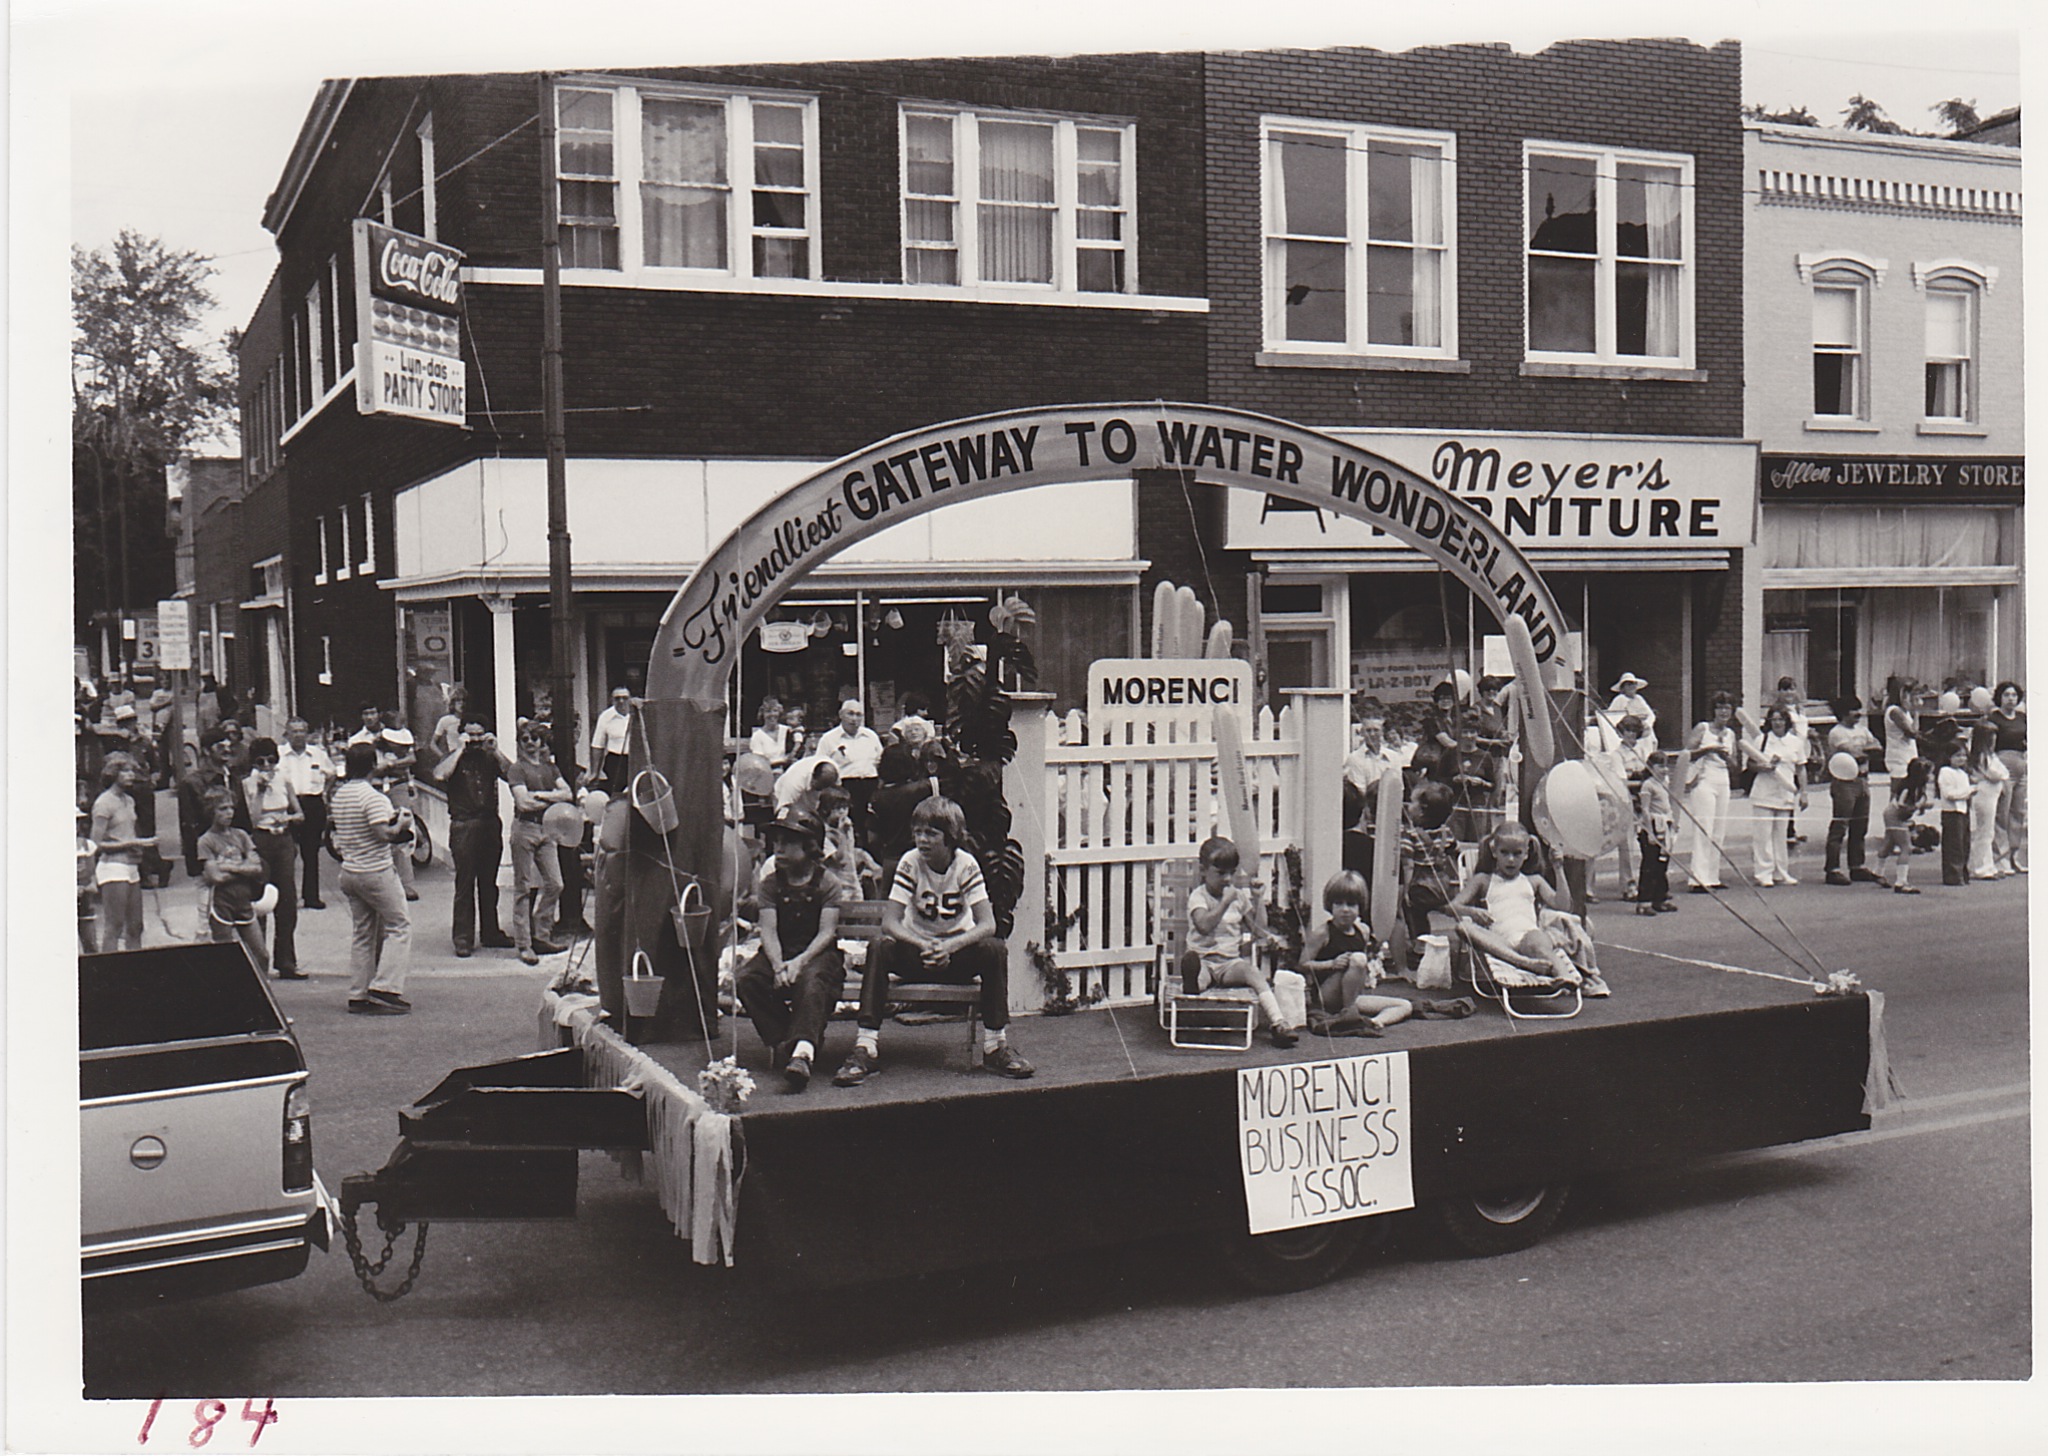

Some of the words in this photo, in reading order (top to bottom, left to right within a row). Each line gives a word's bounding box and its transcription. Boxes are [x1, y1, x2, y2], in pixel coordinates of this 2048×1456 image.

[381, 238, 459, 304] Coca-Cola
[384, 372, 424, 409] PARTY
[428, 381, 464, 417] STORE
[842, 425, 1041, 521] GATEWAY
[1064, 418, 1138, 467] TO
[1156, 420, 1305, 484] WATER
[1432, 440, 1671, 506] Meyer's
[1770, 461, 1832, 490] Allen
[1836, 463, 1948, 486] JEWELRY
[1958, 464, 2025, 487] STORE
[1103, 677, 1239, 705] MORENCI
[1369, 675, 1432, 689] LA-Z-BOY
[919, 890, 964, 921] 35
[1243, 1056, 1392, 1121] MORENCI
[1246, 1108, 1400, 1176] BUSINESS
[1290, 1163, 1378, 1219] ASSOC.
